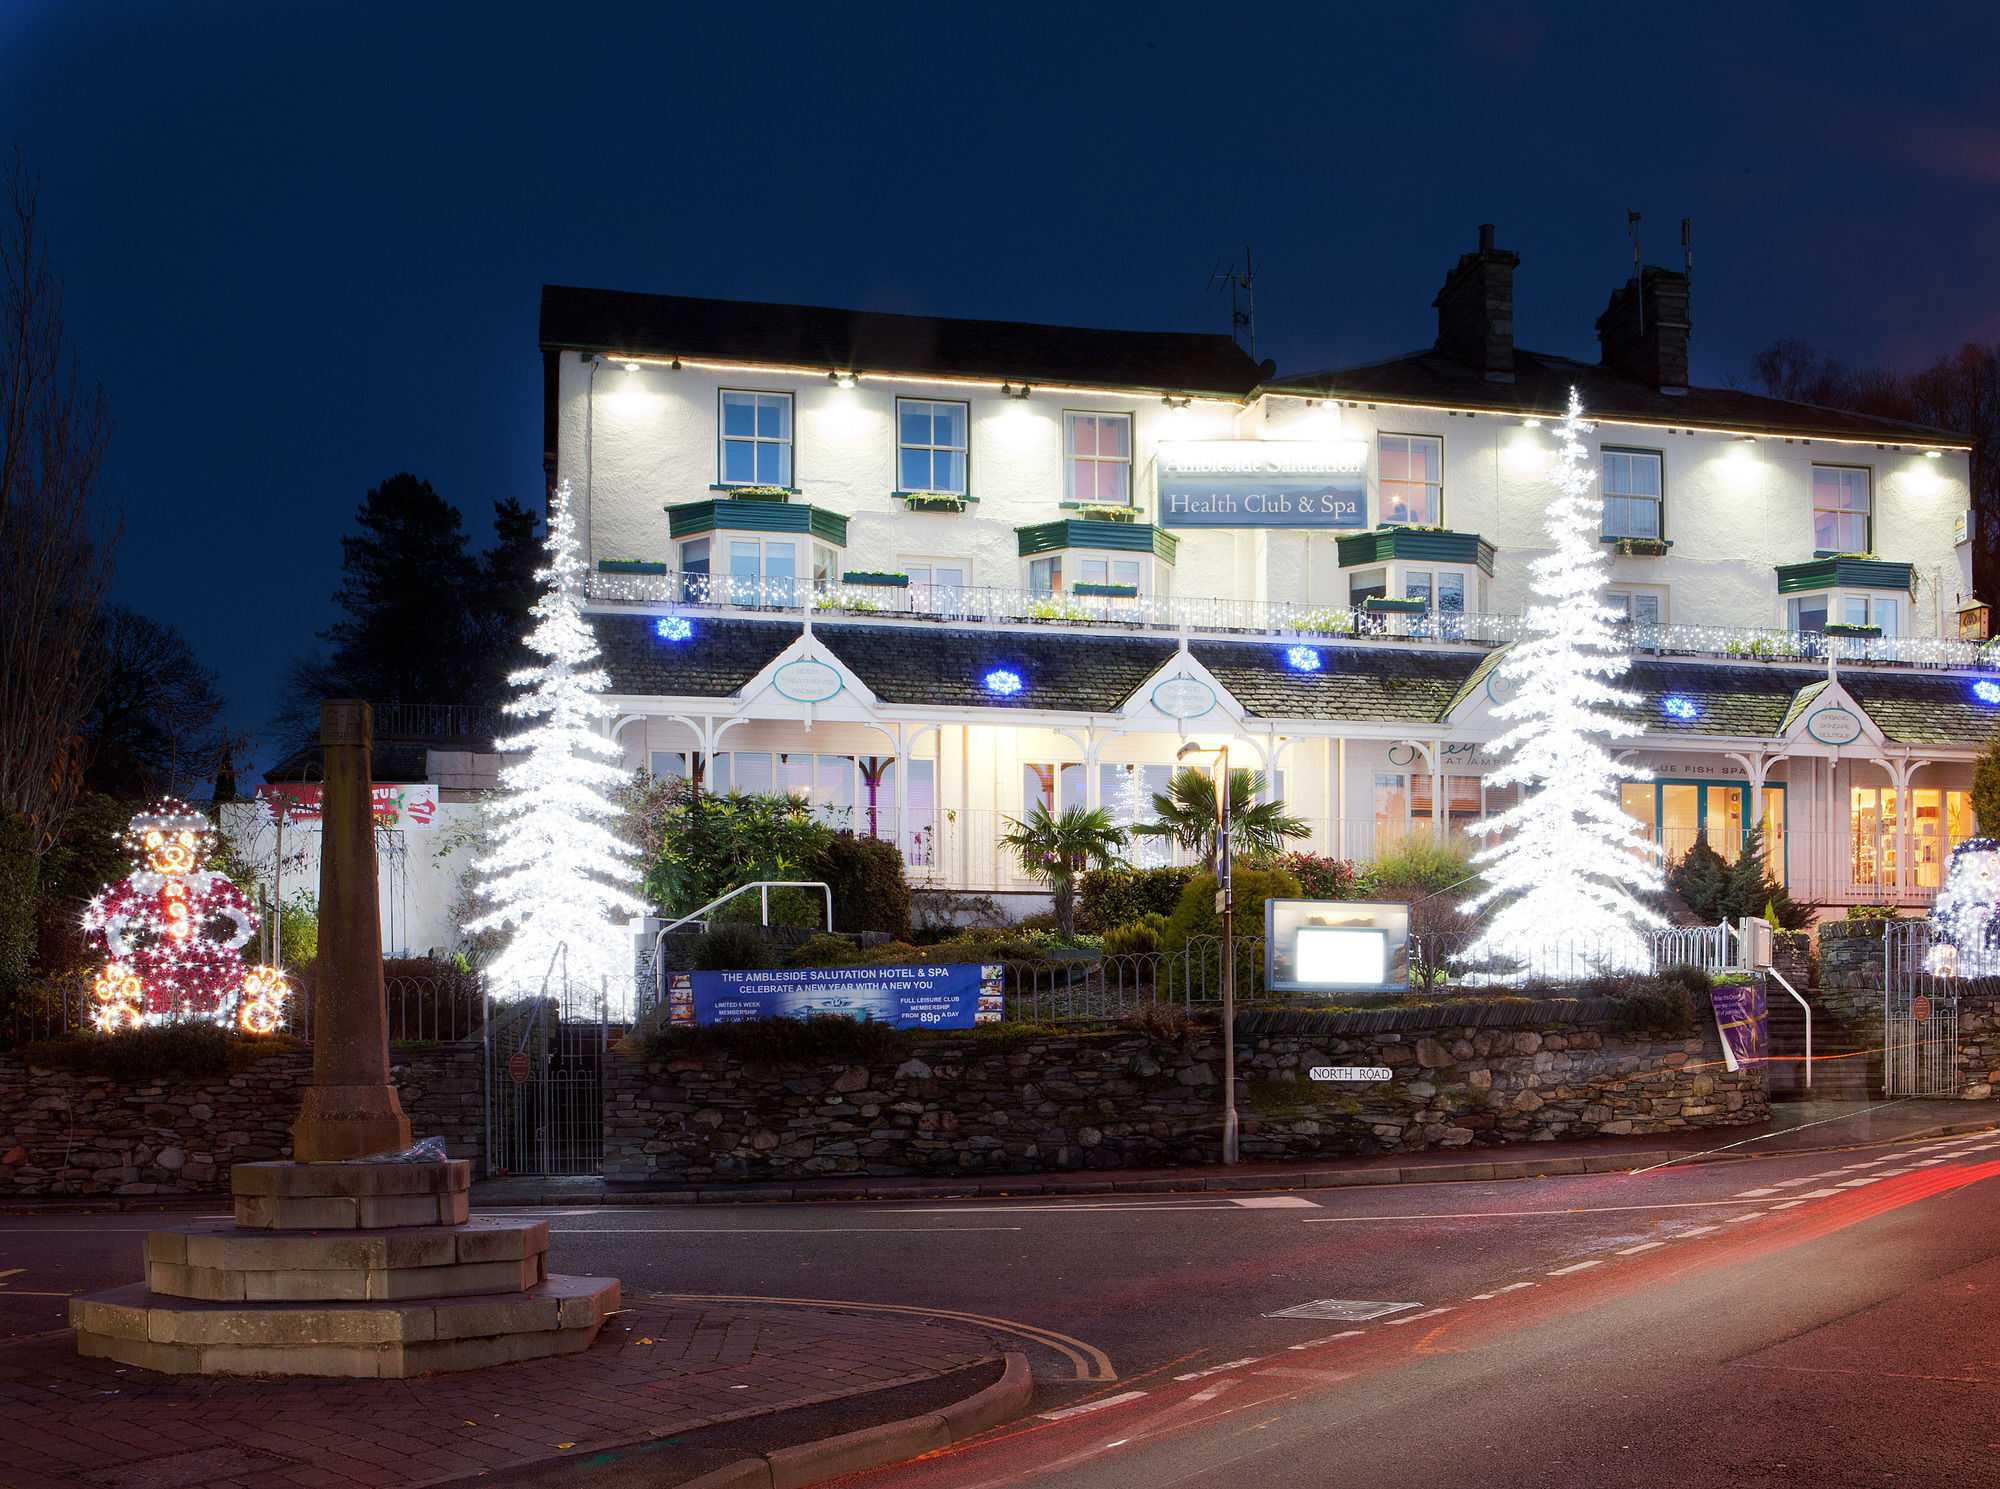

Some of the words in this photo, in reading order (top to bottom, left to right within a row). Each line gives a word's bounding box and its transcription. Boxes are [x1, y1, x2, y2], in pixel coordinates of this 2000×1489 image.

[1170, 493, 1238, 513] Health
[1244, 493, 1292, 513] Club
[1298, 496, 1315, 513] &
[1320, 494, 1357, 519] Spa
[1684, 765, 1714, 774] FISH
[1721, 766, 1747, 775] SPA
[722, 973, 744, 982] THE
[745, 971, 808, 982] AMBLESIDE
[810, 969, 877, 980] SALUTATION
[879, 968, 915, 979] HOTEL
[917, 968, 925, 977] &
[927, 967, 950, 977] SPA
[739, 984, 795, 994] CELEBRATE
[796, 984, 803, 993] A
[803, 983, 827, 993] NEW
[828, 983, 855, 993] YEAR
[856, 982, 880, 991] WITH
[880, 982, 888, 990] A
[889, 981, 912, 991] NEW
[913, 981, 933, 990] YOU
[714, 1001, 738, 1009] LIMITED
[916, 996, 942, 1004] LEISURE
[920, 1012, 941, 1024] 89p
[1313, 1068, 1353, 1079] NORTH
[1359, 1068, 1390, 1080] ROAD
